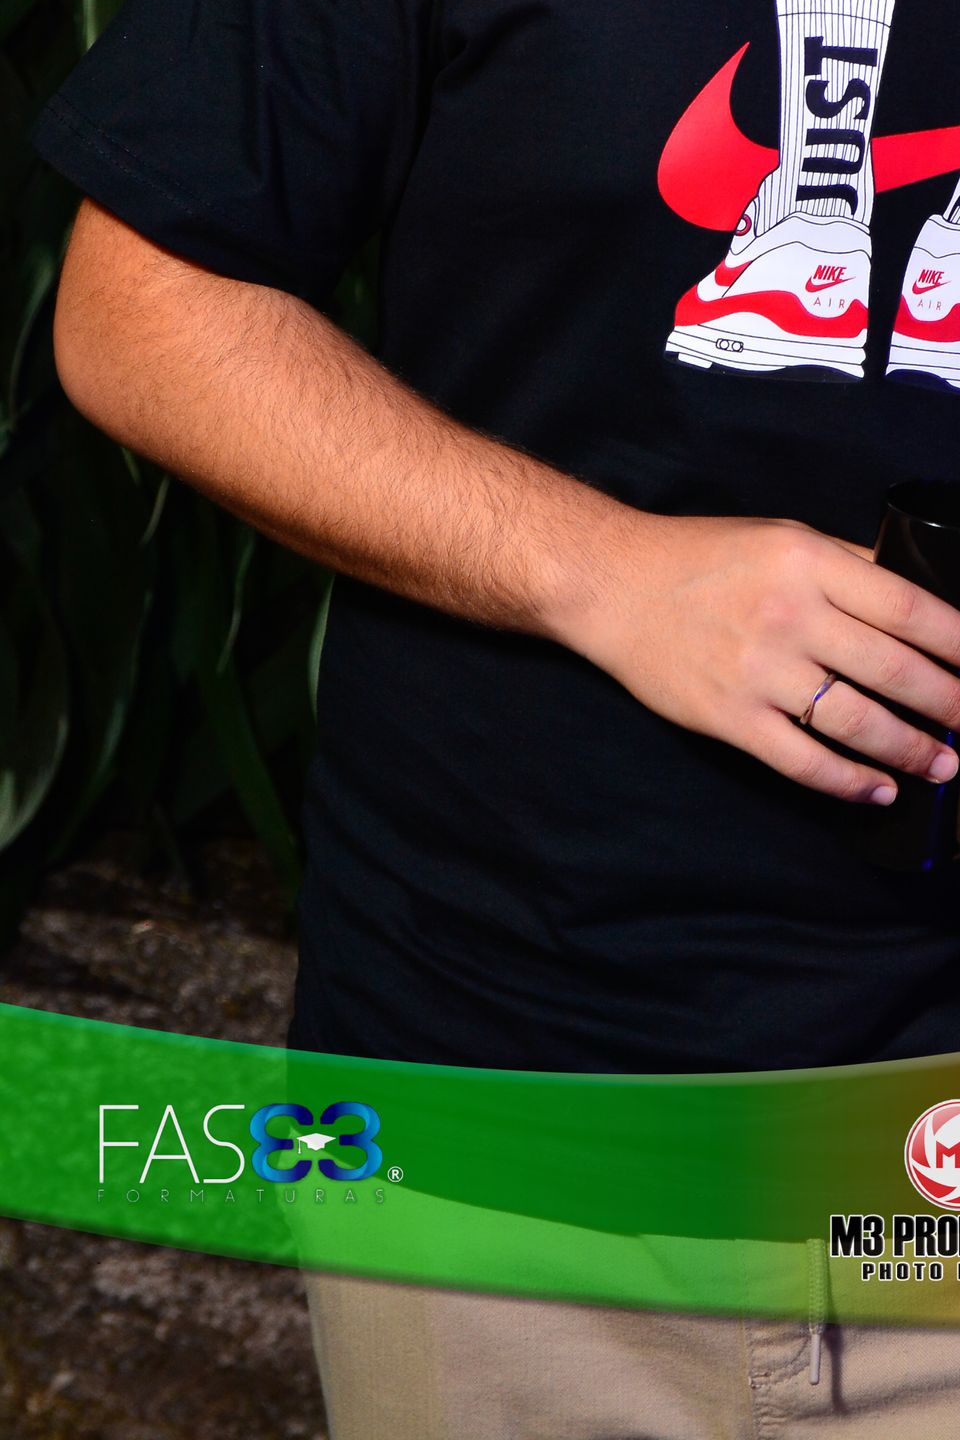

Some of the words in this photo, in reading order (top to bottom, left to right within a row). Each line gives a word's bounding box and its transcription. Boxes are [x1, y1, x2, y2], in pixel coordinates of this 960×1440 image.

[796, 35, 878, 217] JUST
[813, 265, 847, 282] NIKE
[918, 269, 945, 285] NIKE
[813, 297, 846, 309] AIR
[917, 299, 942, 311] AIR
